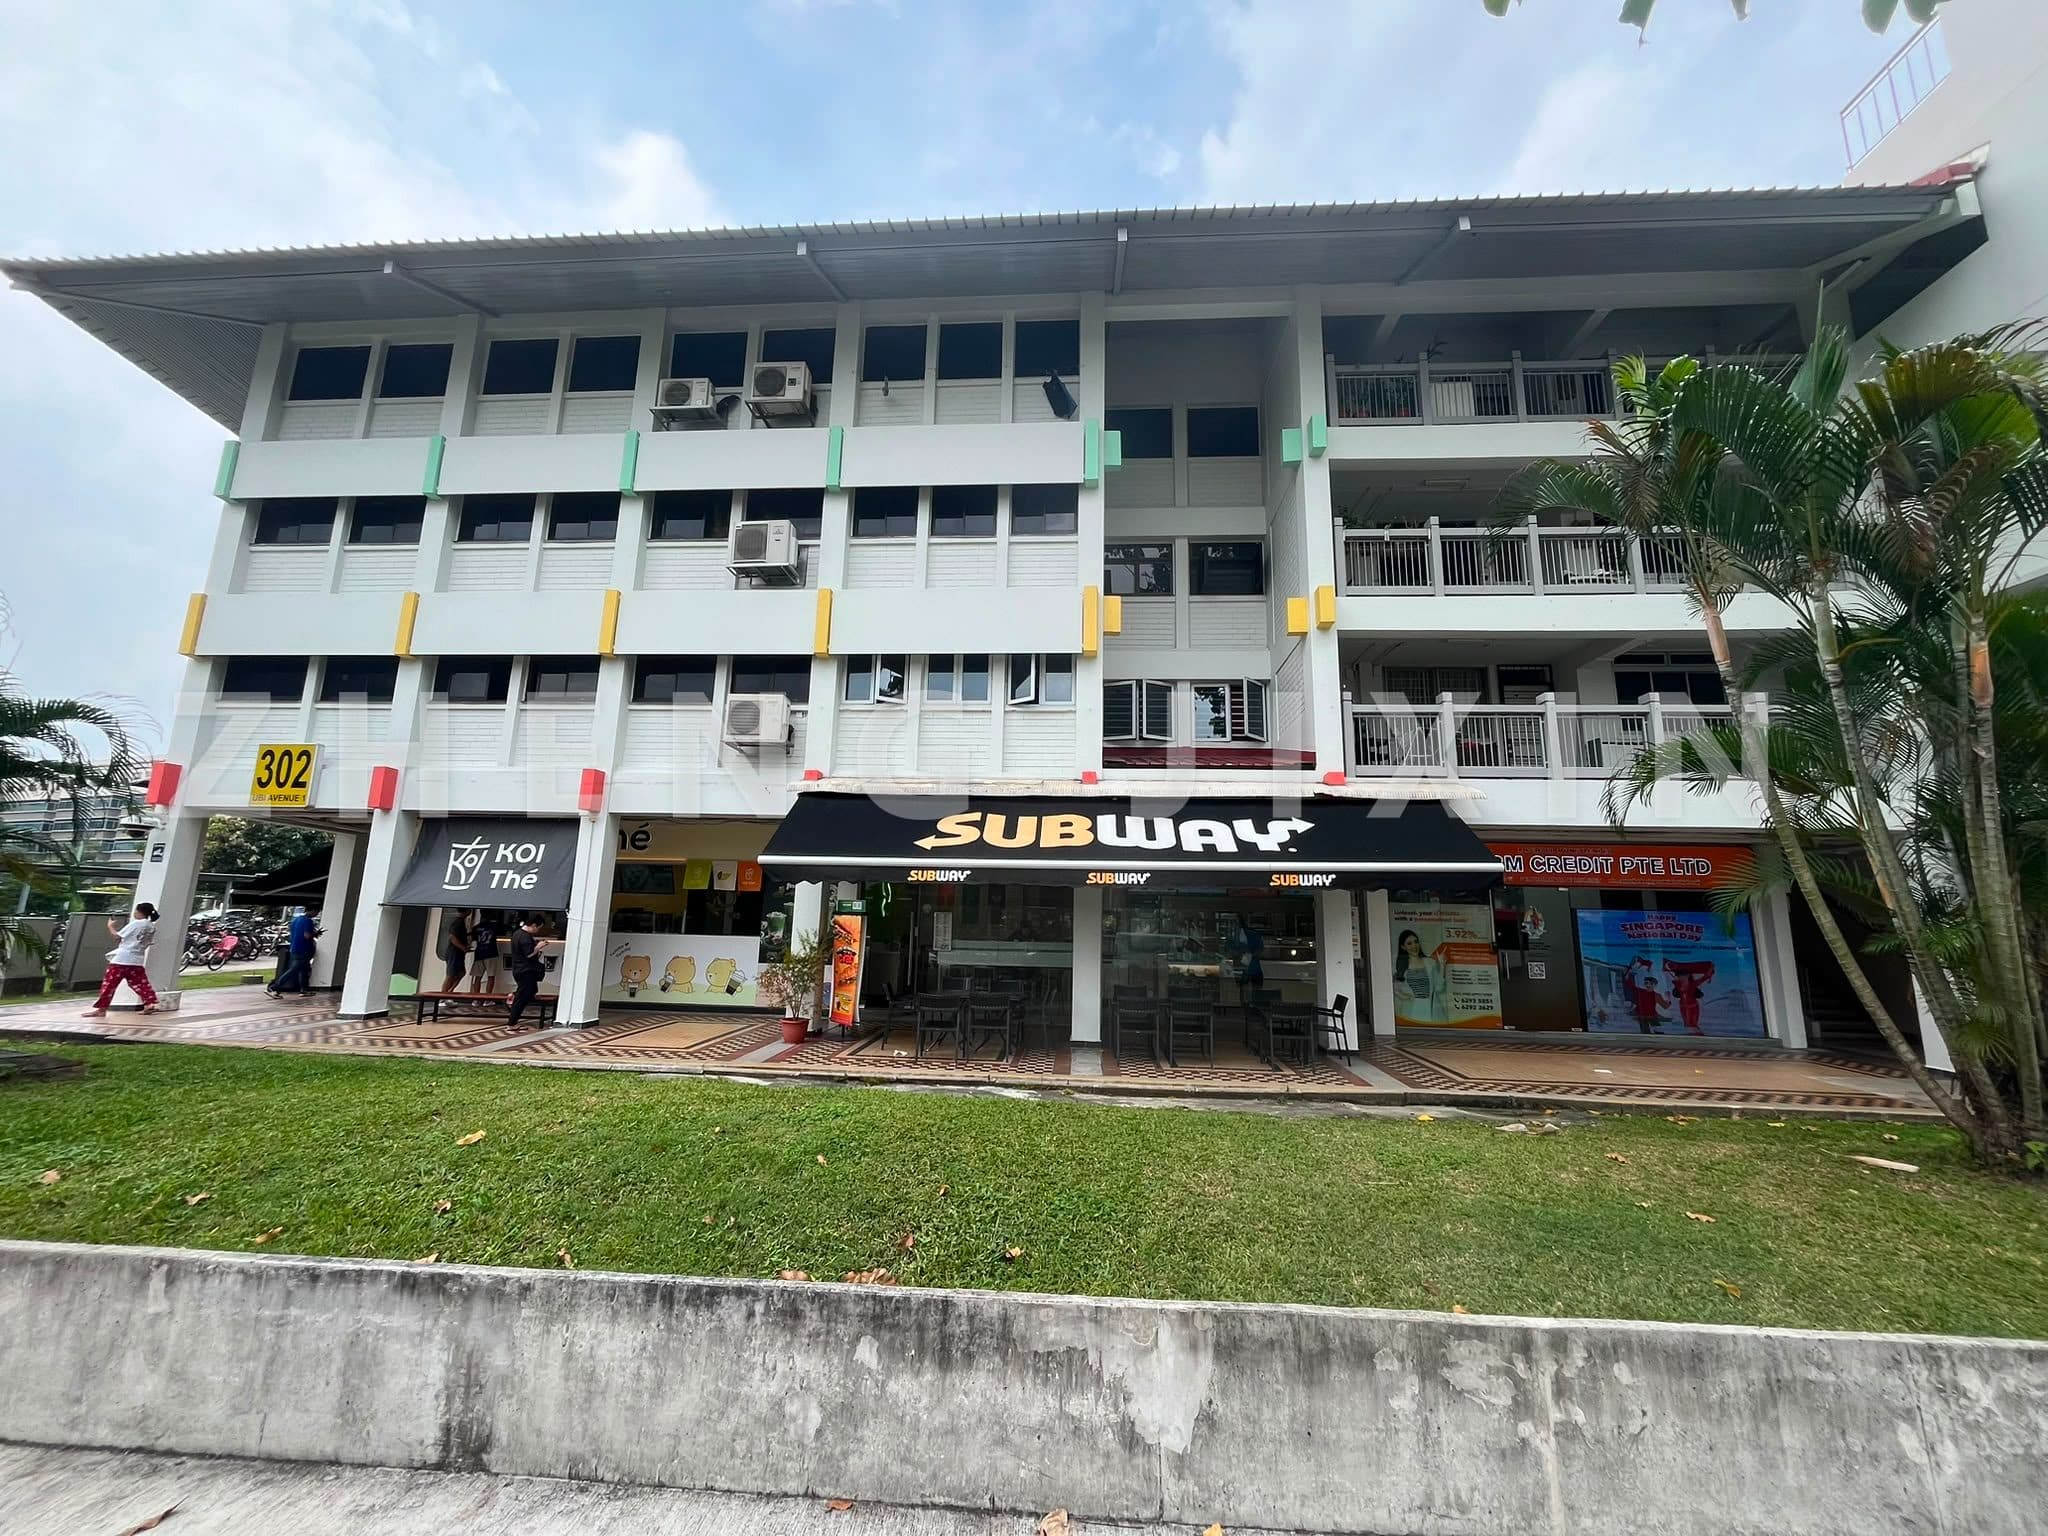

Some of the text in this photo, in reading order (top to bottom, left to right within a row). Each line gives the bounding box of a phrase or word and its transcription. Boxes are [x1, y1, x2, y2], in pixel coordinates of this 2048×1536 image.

[256, 749, 312, 789] 302
[252, 794, 267, 802] UBI
[267, 794, 300, 802] AVENUE
[912, 812, 1316, 852] SUBWAY
[494, 843, 546, 864] KOI
[1529, 855, 1614, 874] CREDIT
[1619, 857, 1665, 875] PTE
[1669, 858, 1712, 876] LTD
[489, 868, 539, 890] Thé
[907, 869, 972, 883] SUBWAY
[1085, 872, 1152, 885] SUBWAY
[1269, 873, 1337, 888] SUBWAY
[1619, 922, 1704, 934] SINGAPORE
[1626, 931, 1702, 942] National Day
